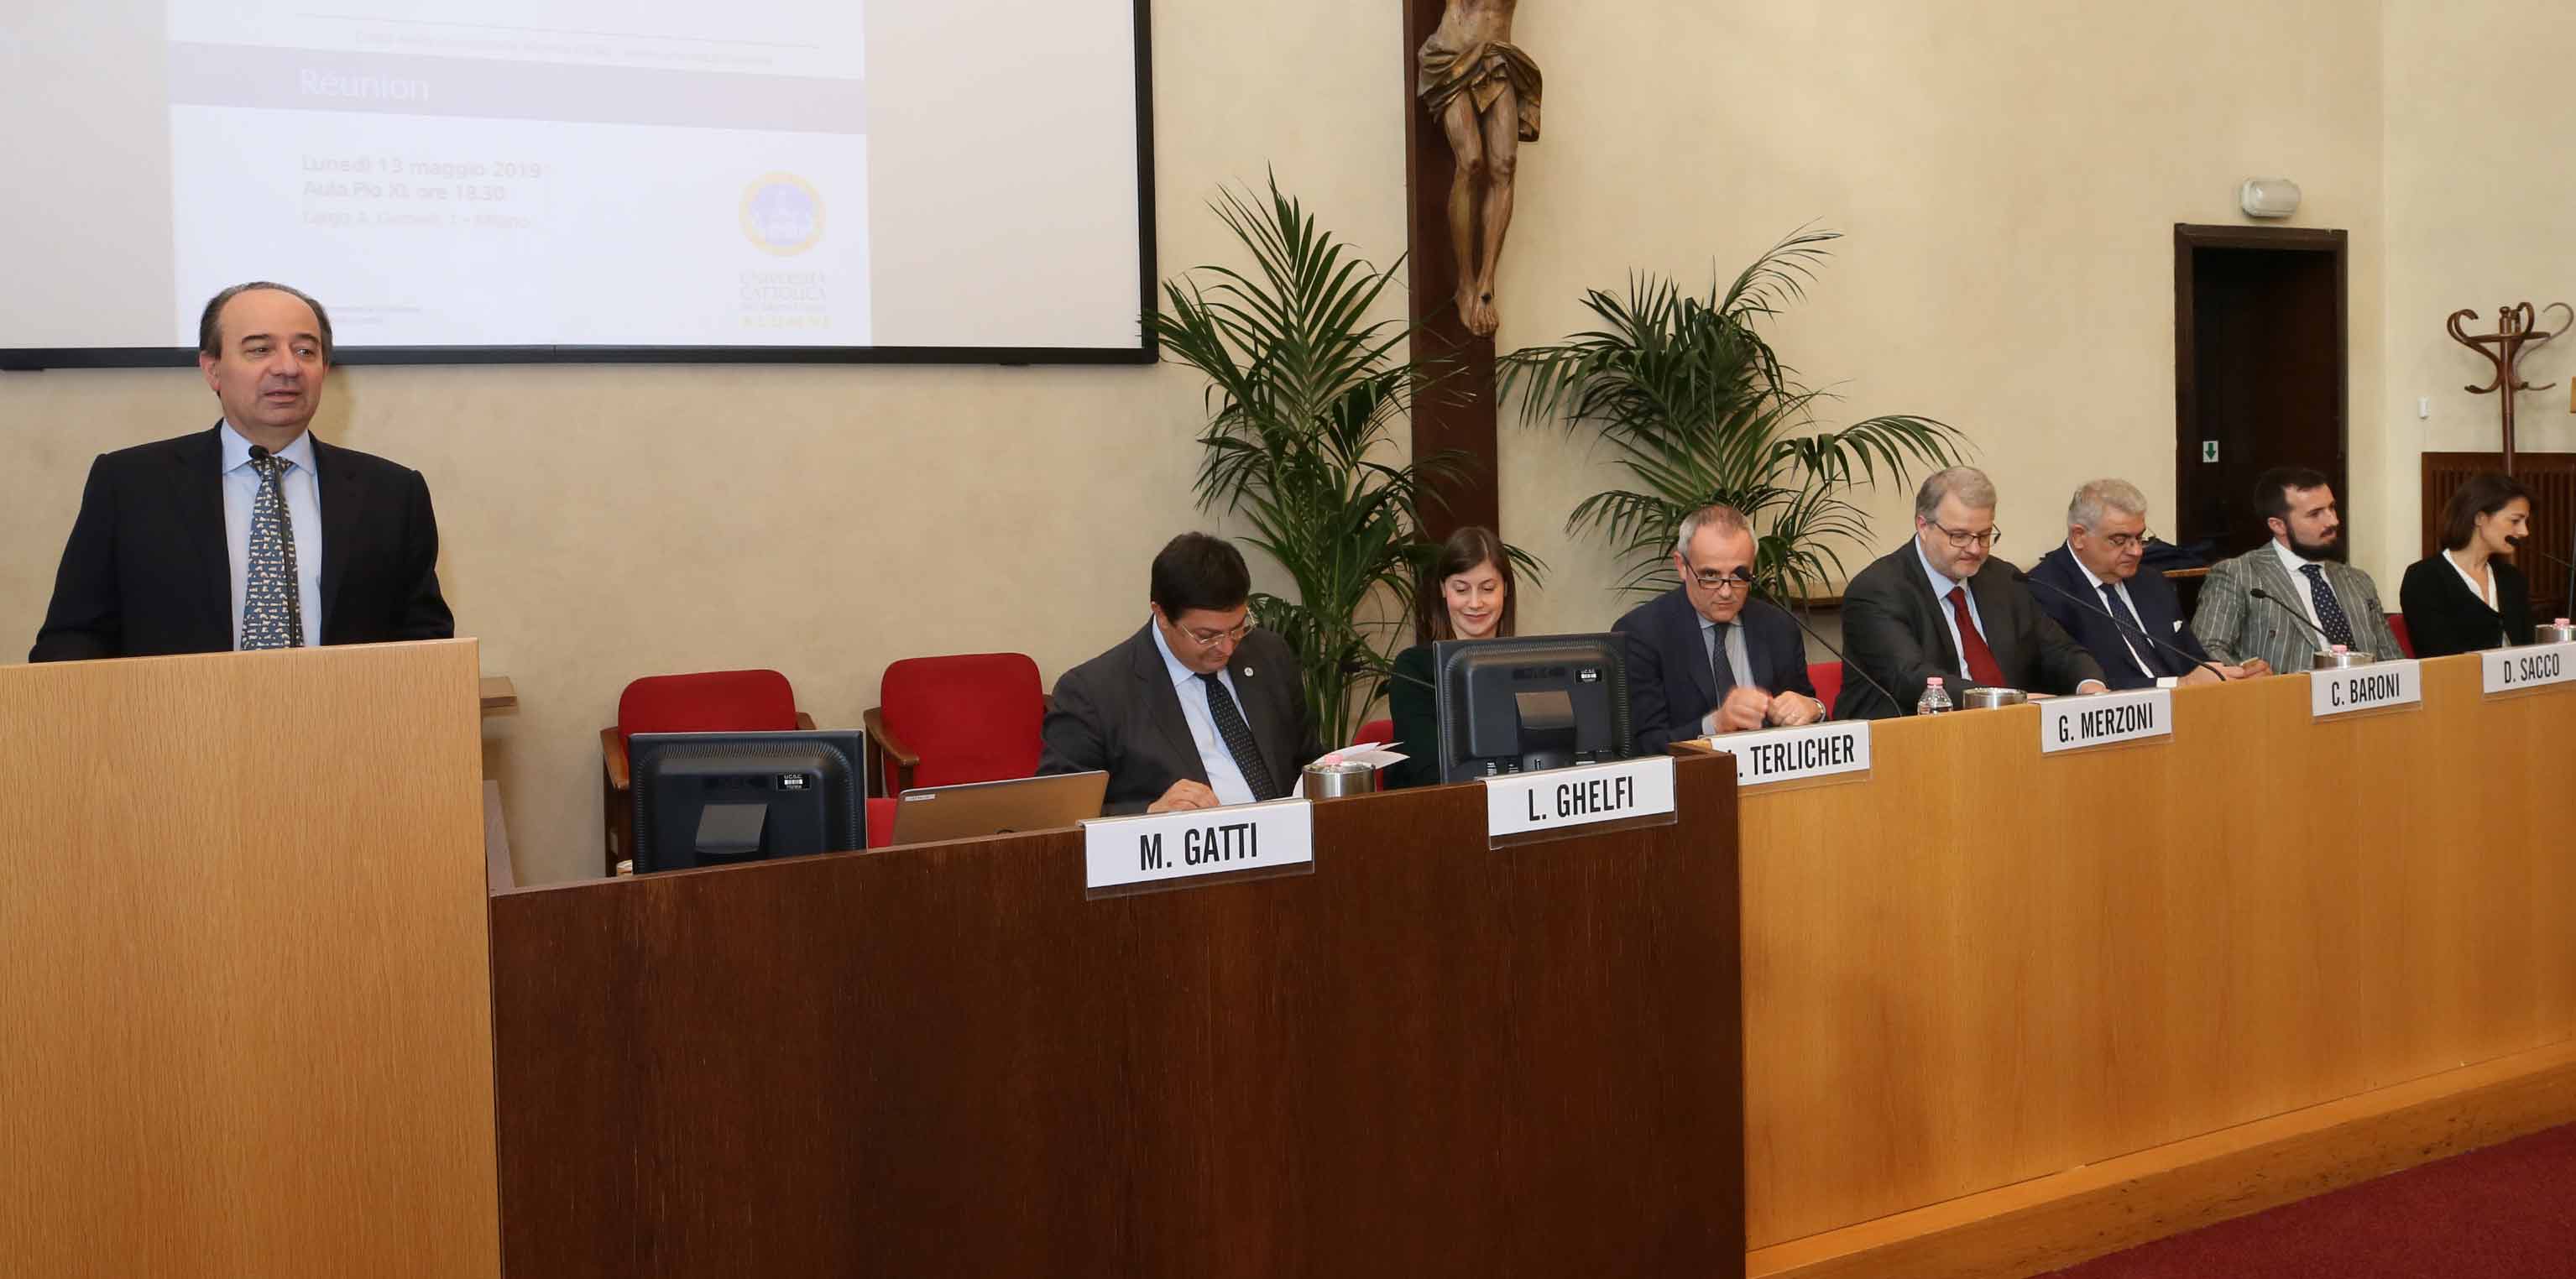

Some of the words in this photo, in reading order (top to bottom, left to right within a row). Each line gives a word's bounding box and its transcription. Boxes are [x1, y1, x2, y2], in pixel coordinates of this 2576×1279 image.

[378, 156, 403, 174] 13
[409, 160, 487, 180] maggio
[490, 159, 542, 180] 2019
[302, 180, 348, 198] Aula
[415, 186, 449, 201] ore
[2504, 660, 2517, 684] D.
[2520, 654, 2560, 681] SACCO
[2331, 681, 2345, 707] C.
[2349, 673, 2401, 704] BARONI
[2058, 715, 2075, 744] G.
[2081, 702, 2154, 739] MERZONI
[1750, 735, 1855, 776] TERLICHER
[1528, 789, 1548, 822] L.
[1556, 775, 1634, 818] GHELFI
[1140, 833, 1173, 872] M.
[1183, 822, 1258, 866] GATTI
